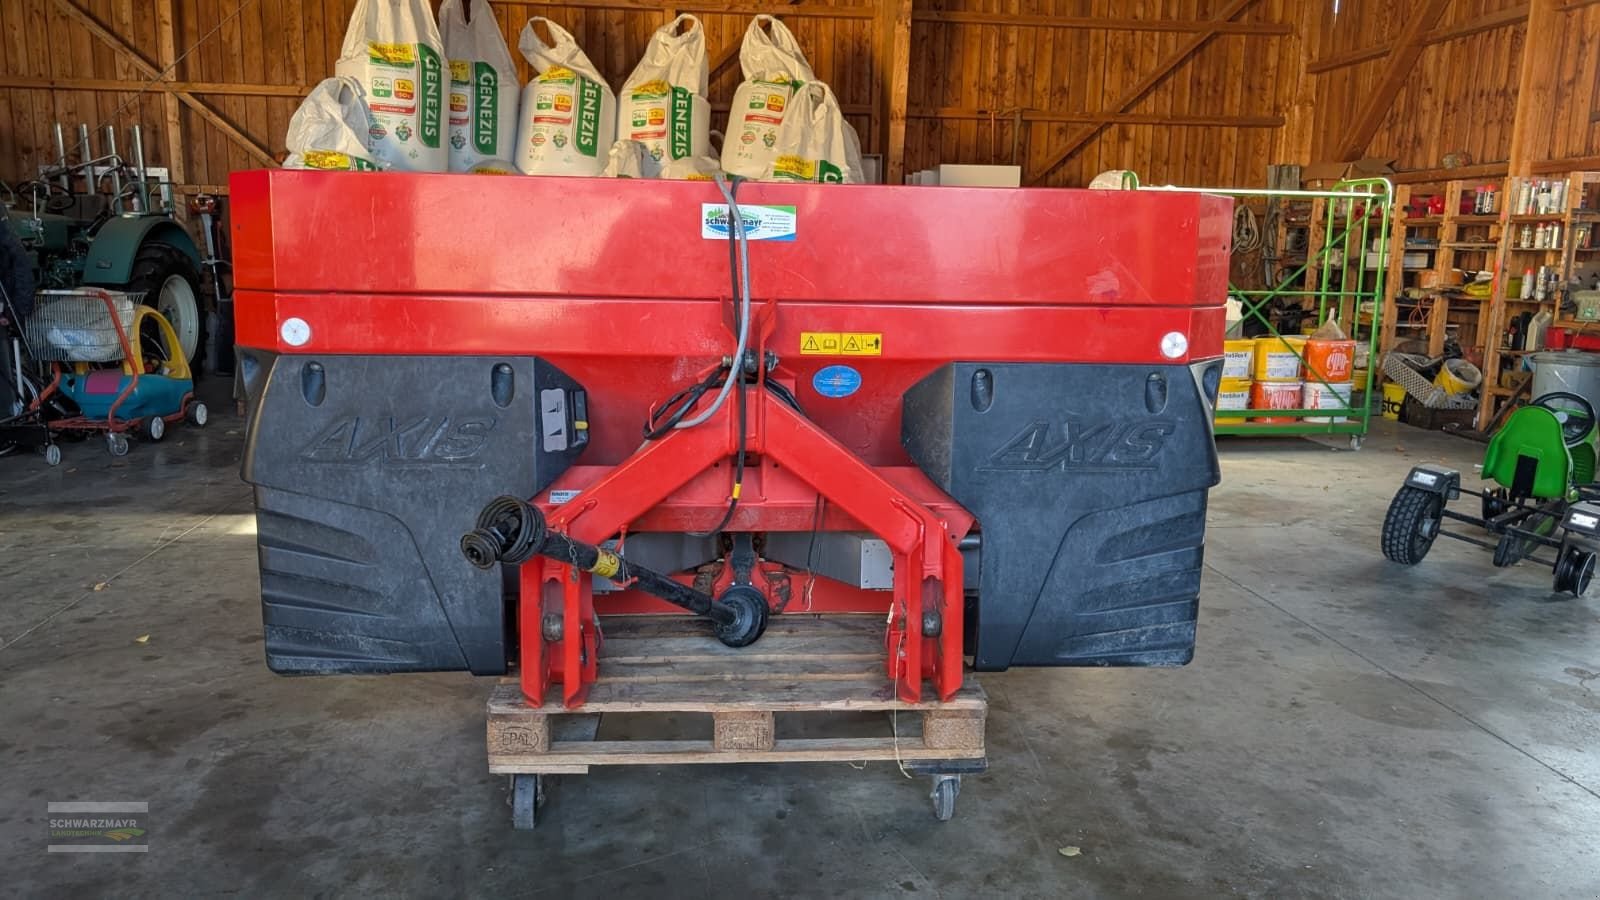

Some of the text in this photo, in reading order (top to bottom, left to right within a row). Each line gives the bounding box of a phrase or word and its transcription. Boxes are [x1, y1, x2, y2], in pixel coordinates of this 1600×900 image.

[425, 55, 440, 136] GENEZIS
[480, 72, 495, 145] GENEZIS
[301, 415, 497, 461] AXIS
[989, 420, 1177, 464] AXIS
